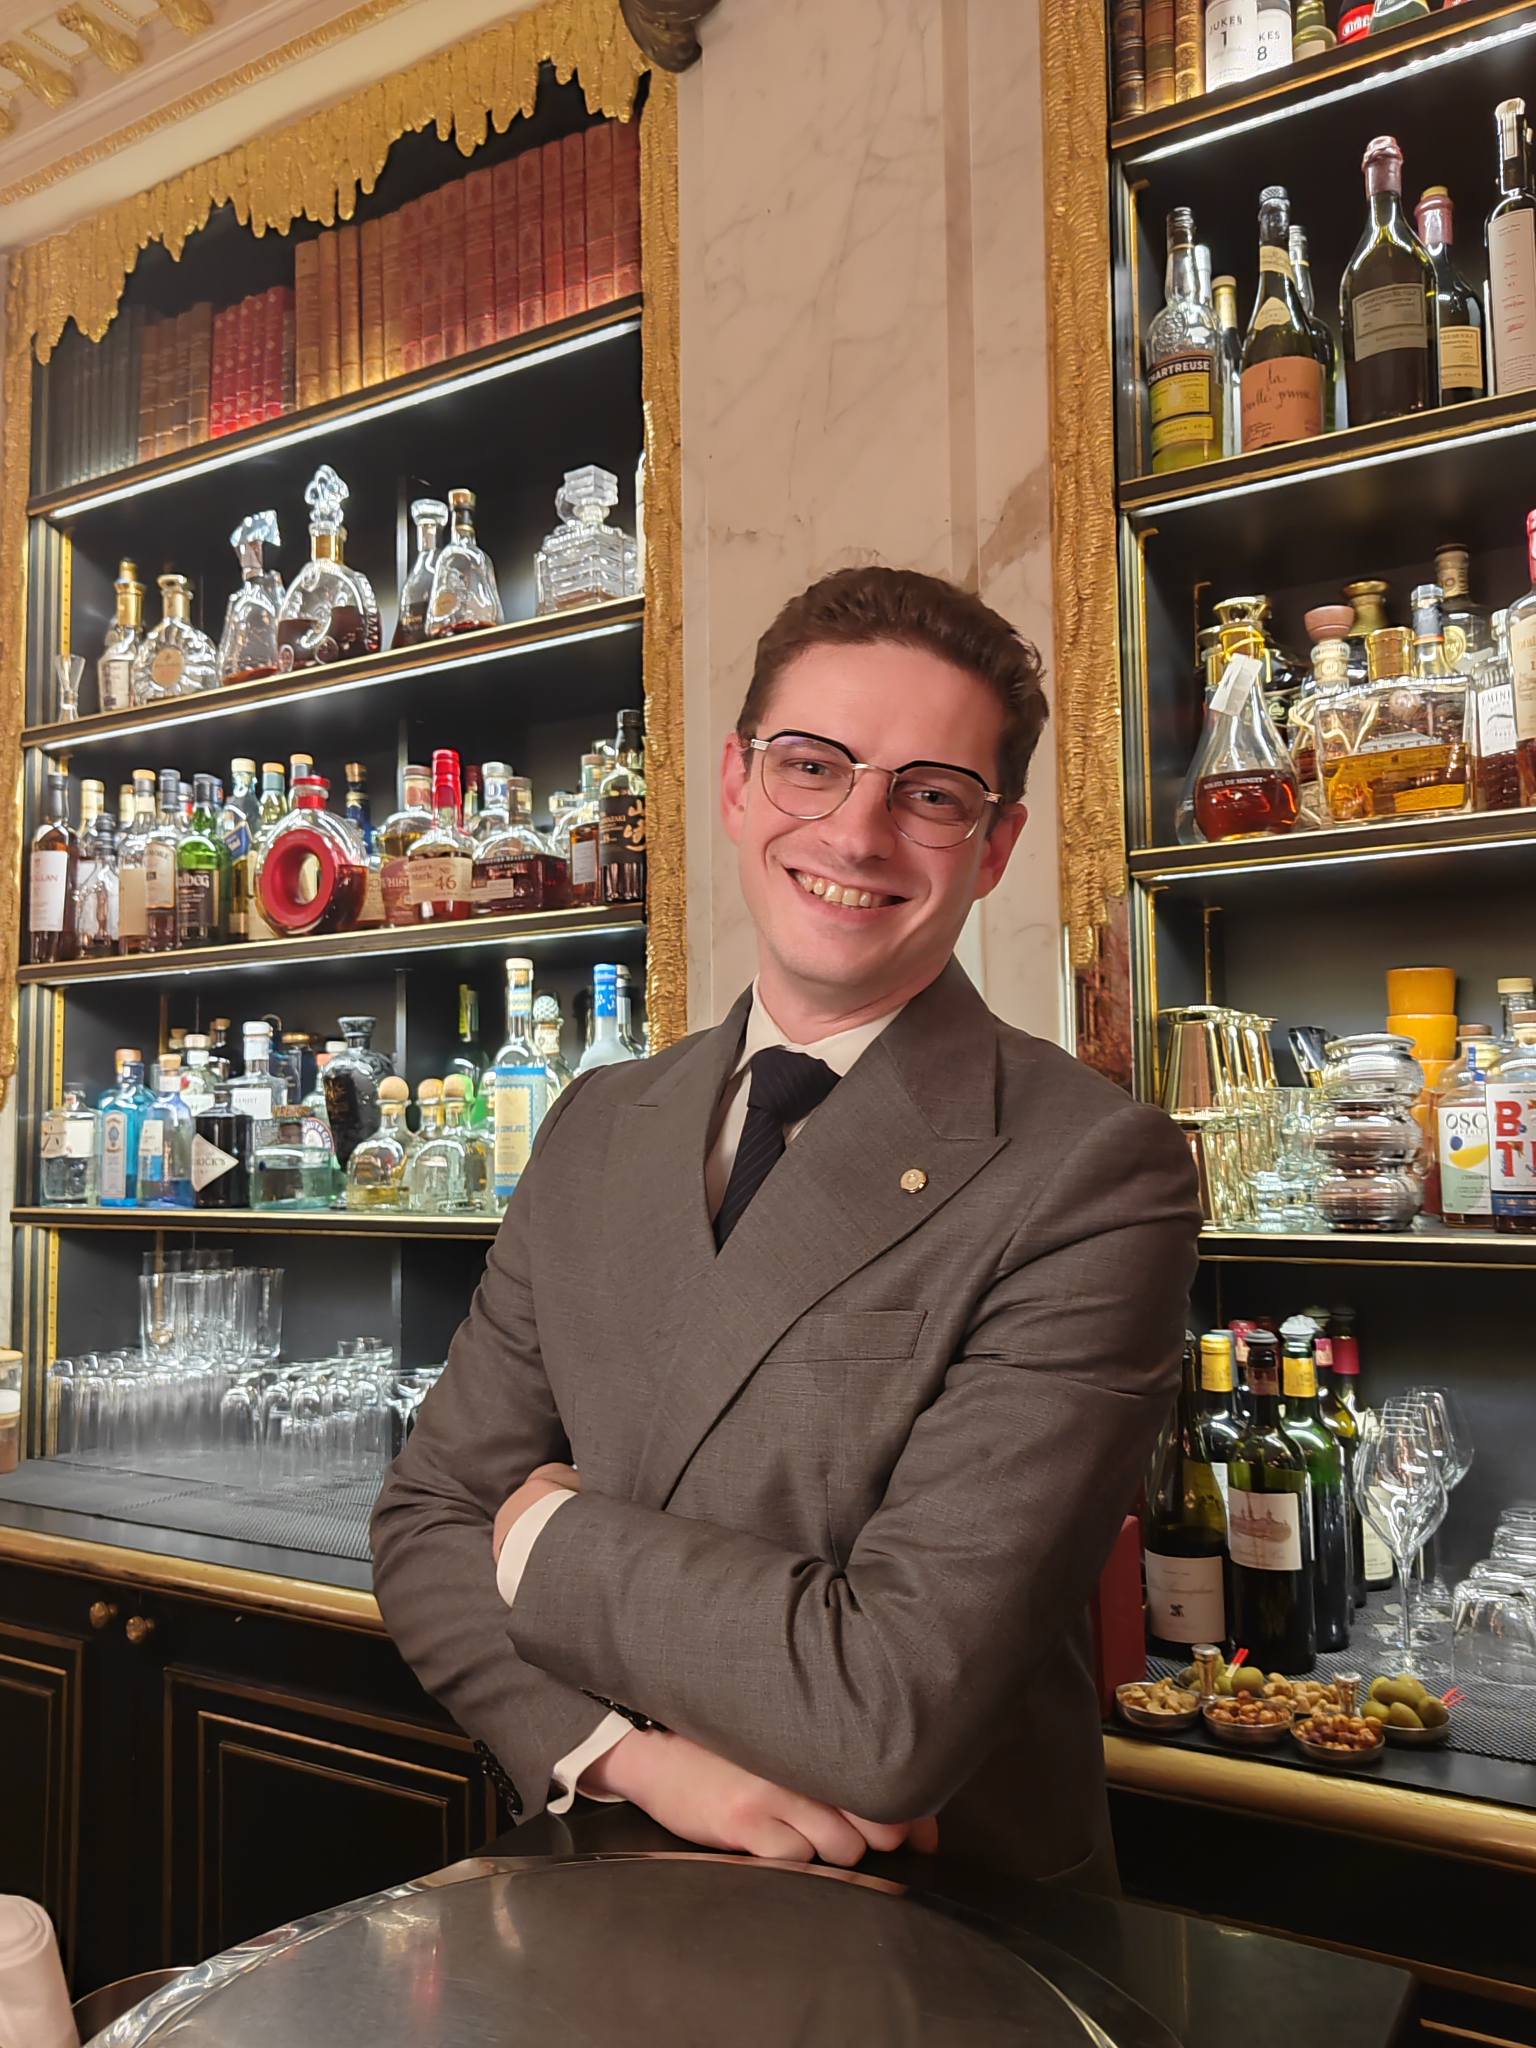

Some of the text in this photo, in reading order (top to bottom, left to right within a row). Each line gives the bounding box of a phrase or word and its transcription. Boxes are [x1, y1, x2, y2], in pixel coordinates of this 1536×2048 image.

[1221, 30, 1228, 48] 1
[1258, 31, 1281, 42] KES
[1257, 46, 1268, 61] 8
[1148, 360, 1210, 386] CHARTREUSE
[435, 874, 457, 890] 46
[1446, 1112, 1488, 1130] OSC
